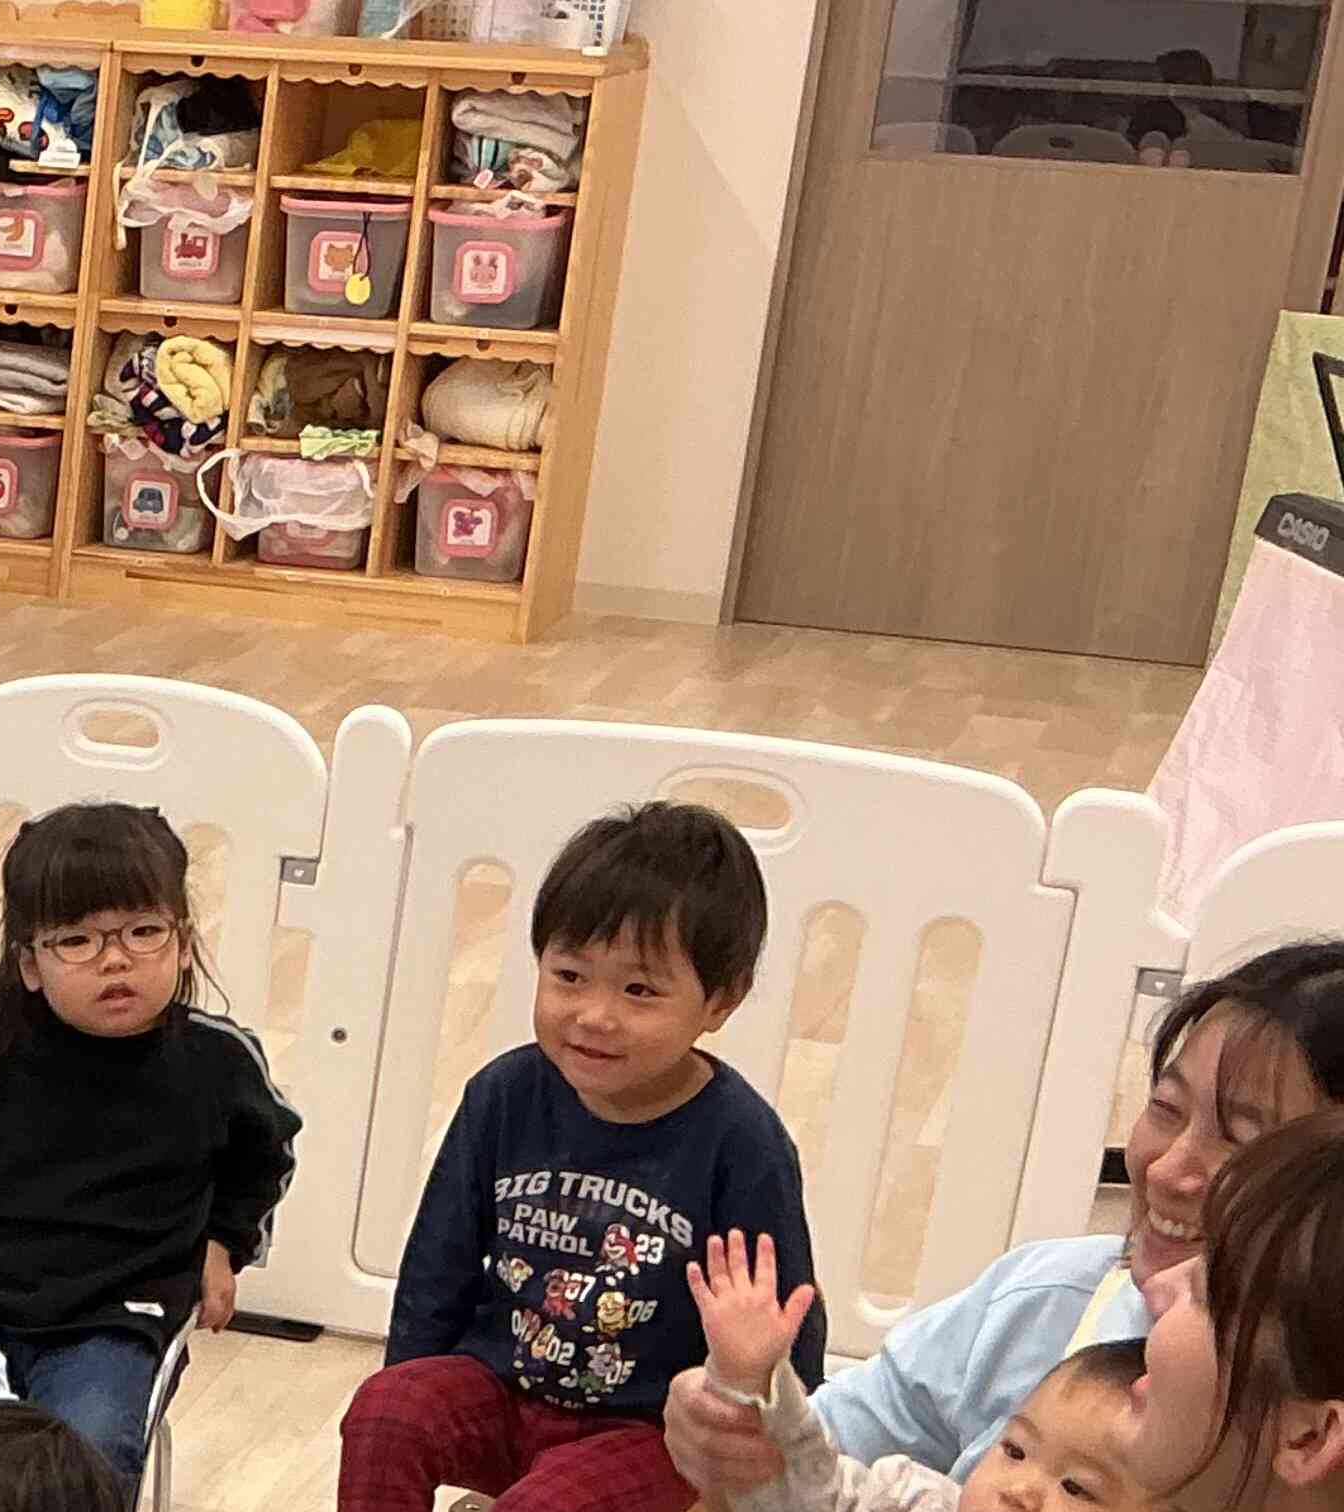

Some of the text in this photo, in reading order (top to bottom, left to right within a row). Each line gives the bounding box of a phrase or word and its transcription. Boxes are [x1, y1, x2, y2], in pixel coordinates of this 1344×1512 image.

[1277, 512, 1330, 551] CASIO
[494, 1170, 693, 1248] BIG TRUCKS
[514, 1203, 579, 1233] PAW
[497, 1217, 594, 1257] PATROL
[635, 1233, 665, 1265] 23
[545, 1335, 576, 1366] 02
